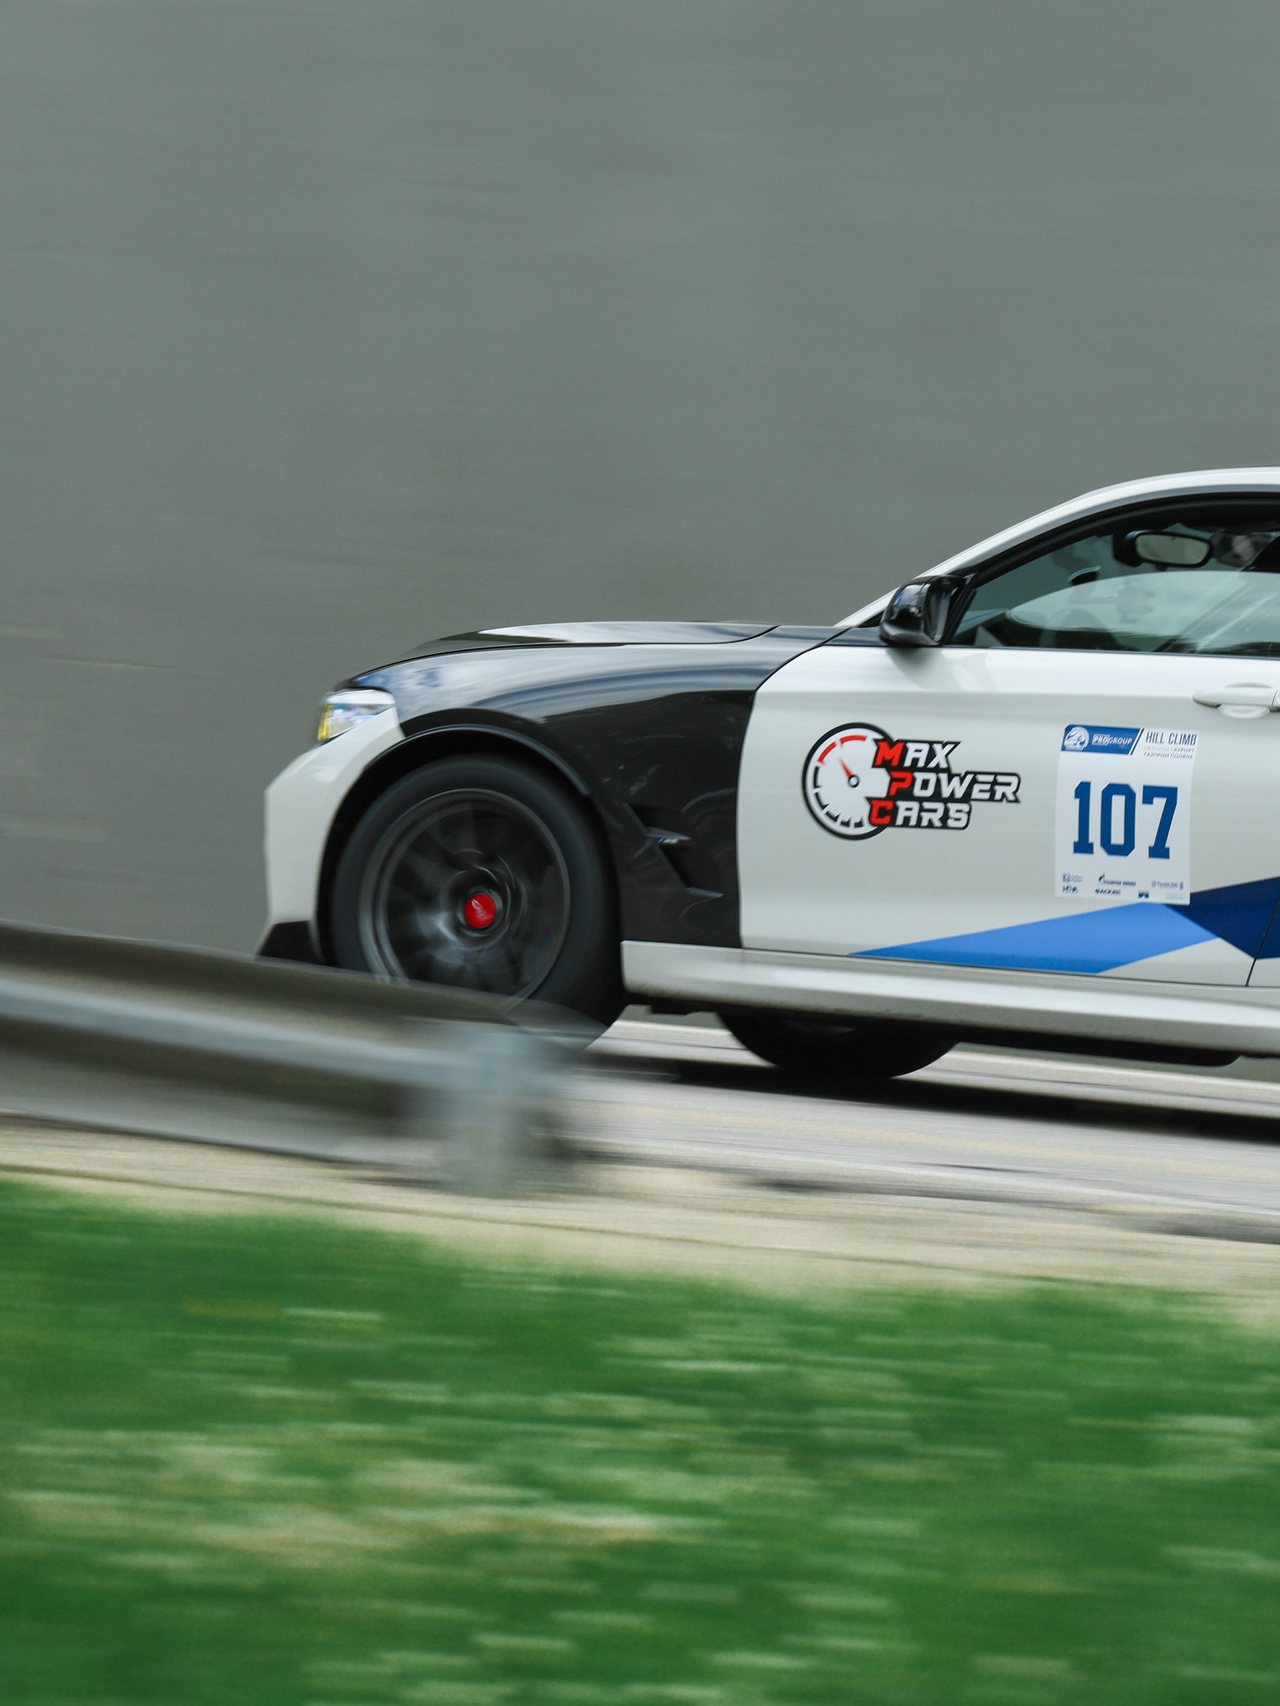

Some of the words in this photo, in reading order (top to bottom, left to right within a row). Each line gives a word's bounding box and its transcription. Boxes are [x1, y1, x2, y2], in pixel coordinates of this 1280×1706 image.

[1145, 731, 1165, 744] HILL
[1168, 732, 1198, 746] CLIMB
[875, 741, 955, 768] MAX
[889, 771, 1019, 802] POWER
[869, 799, 970, 828] CARS
[1073, 781, 1178, 860] 107
